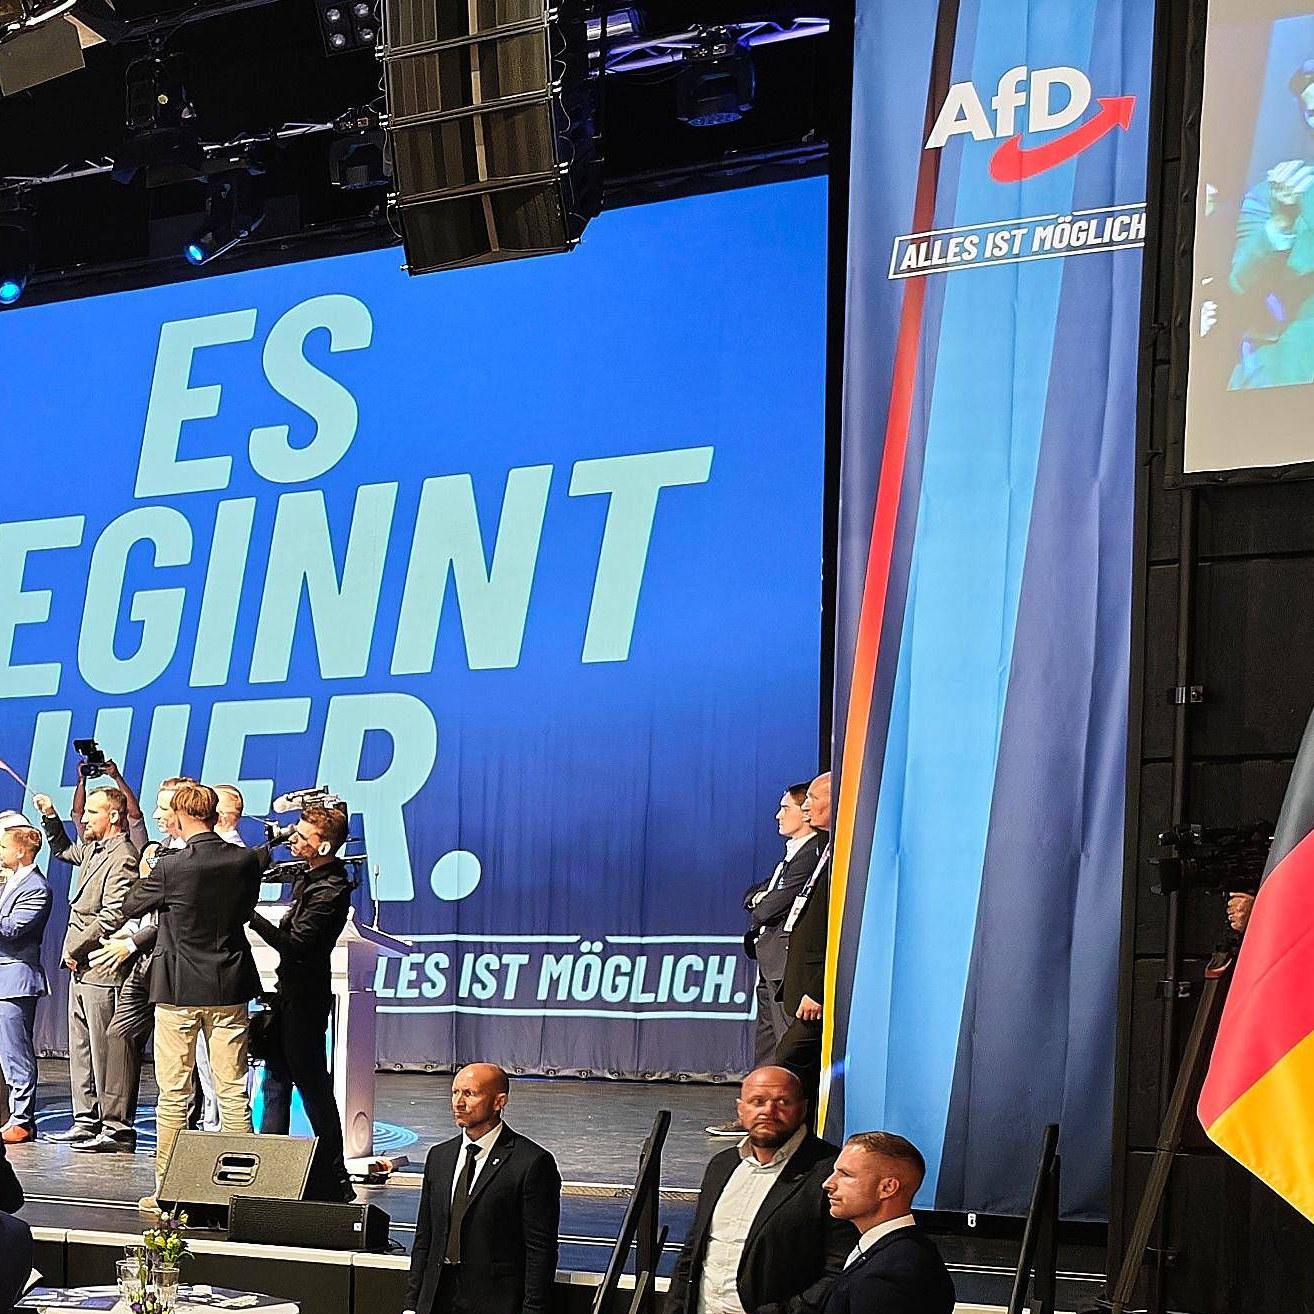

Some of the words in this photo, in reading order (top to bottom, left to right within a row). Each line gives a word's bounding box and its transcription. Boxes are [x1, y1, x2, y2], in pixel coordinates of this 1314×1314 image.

[924, 65, 1091, 149] AfD
[901, 235, 978, 270] ALLES
[984, 226, 1024, 260] IST
[135, 293, 374, 498] ES
[374, 953, 450, 999] LES
[458, 953, 529, 1000] IST
[537, 941, 747, 1004] MÖGLICH.
